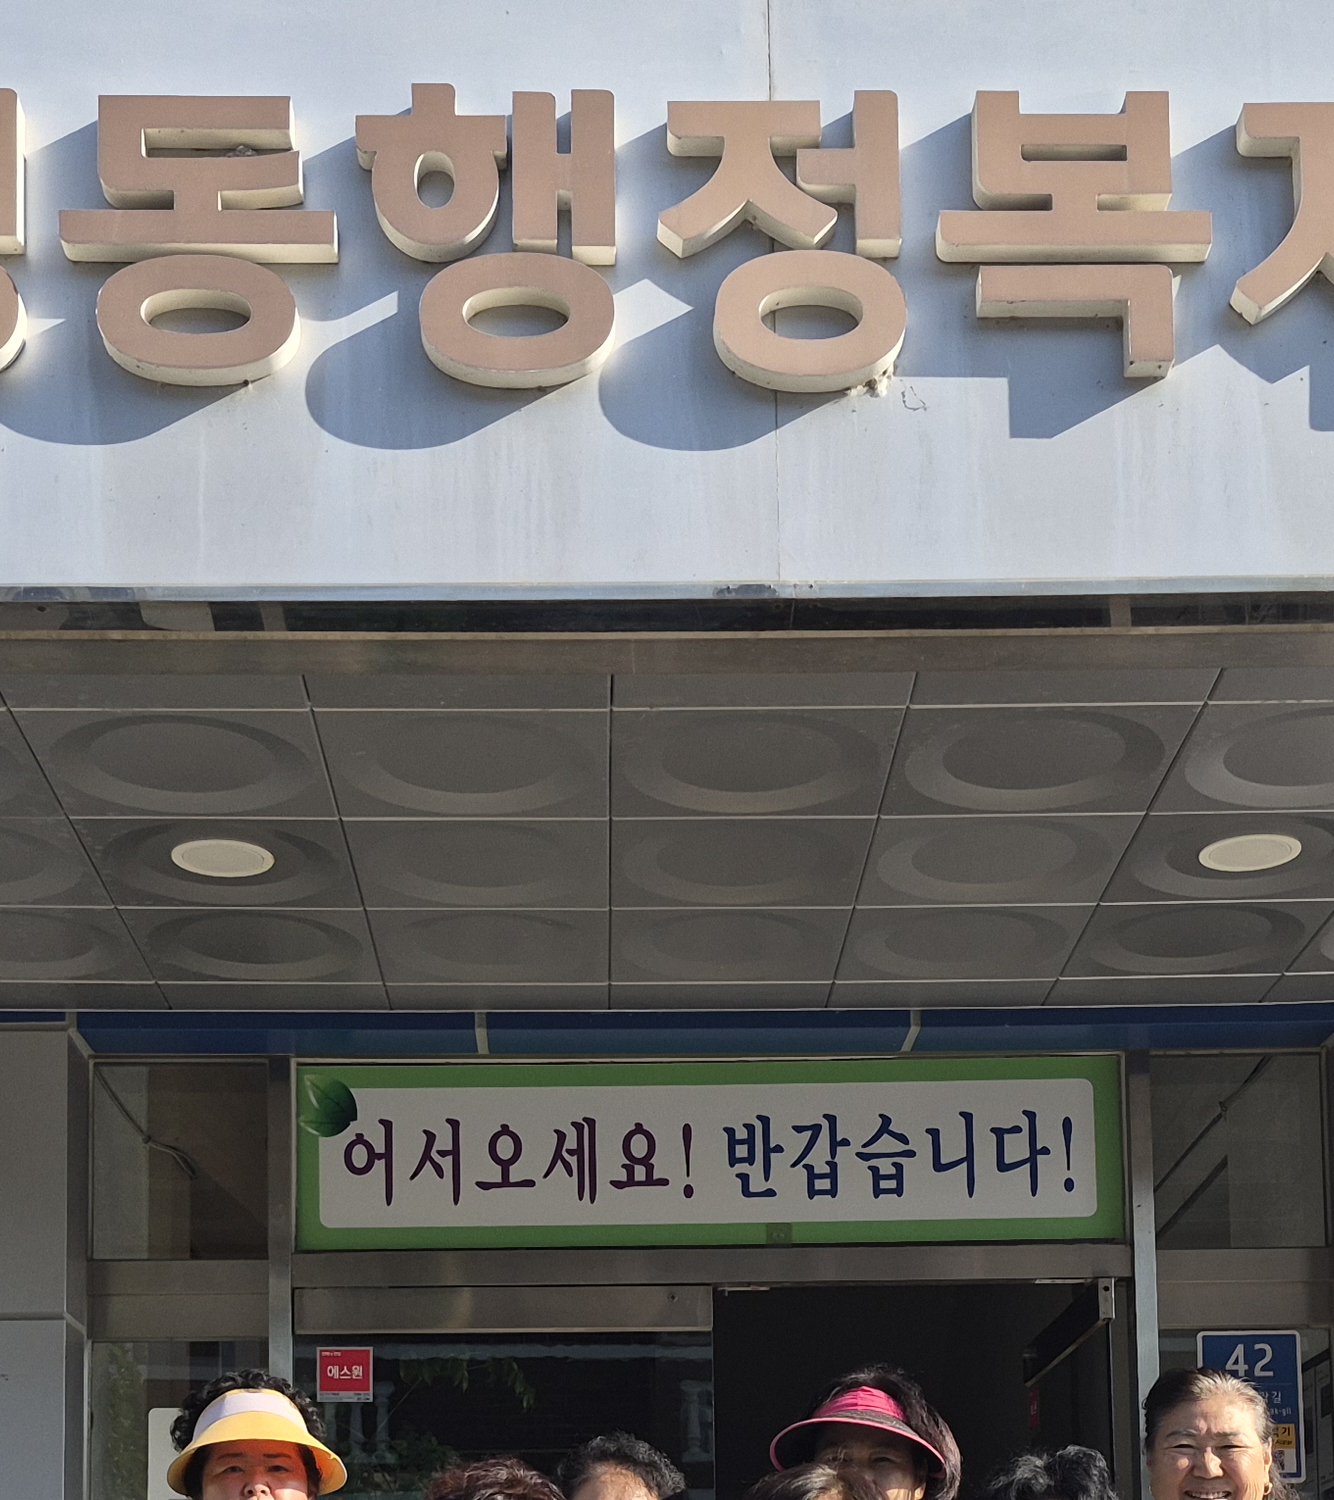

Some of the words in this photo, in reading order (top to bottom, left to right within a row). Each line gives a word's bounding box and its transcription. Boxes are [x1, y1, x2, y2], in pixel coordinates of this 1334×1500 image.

[343, 1116, 695, 1207] 어서오세요!
[722, 1110, 1076, 1200] 반갑습니다!
[326, 1365, 363, 1379] 에스원
[1225, 1343, 1274, 1377] 42
